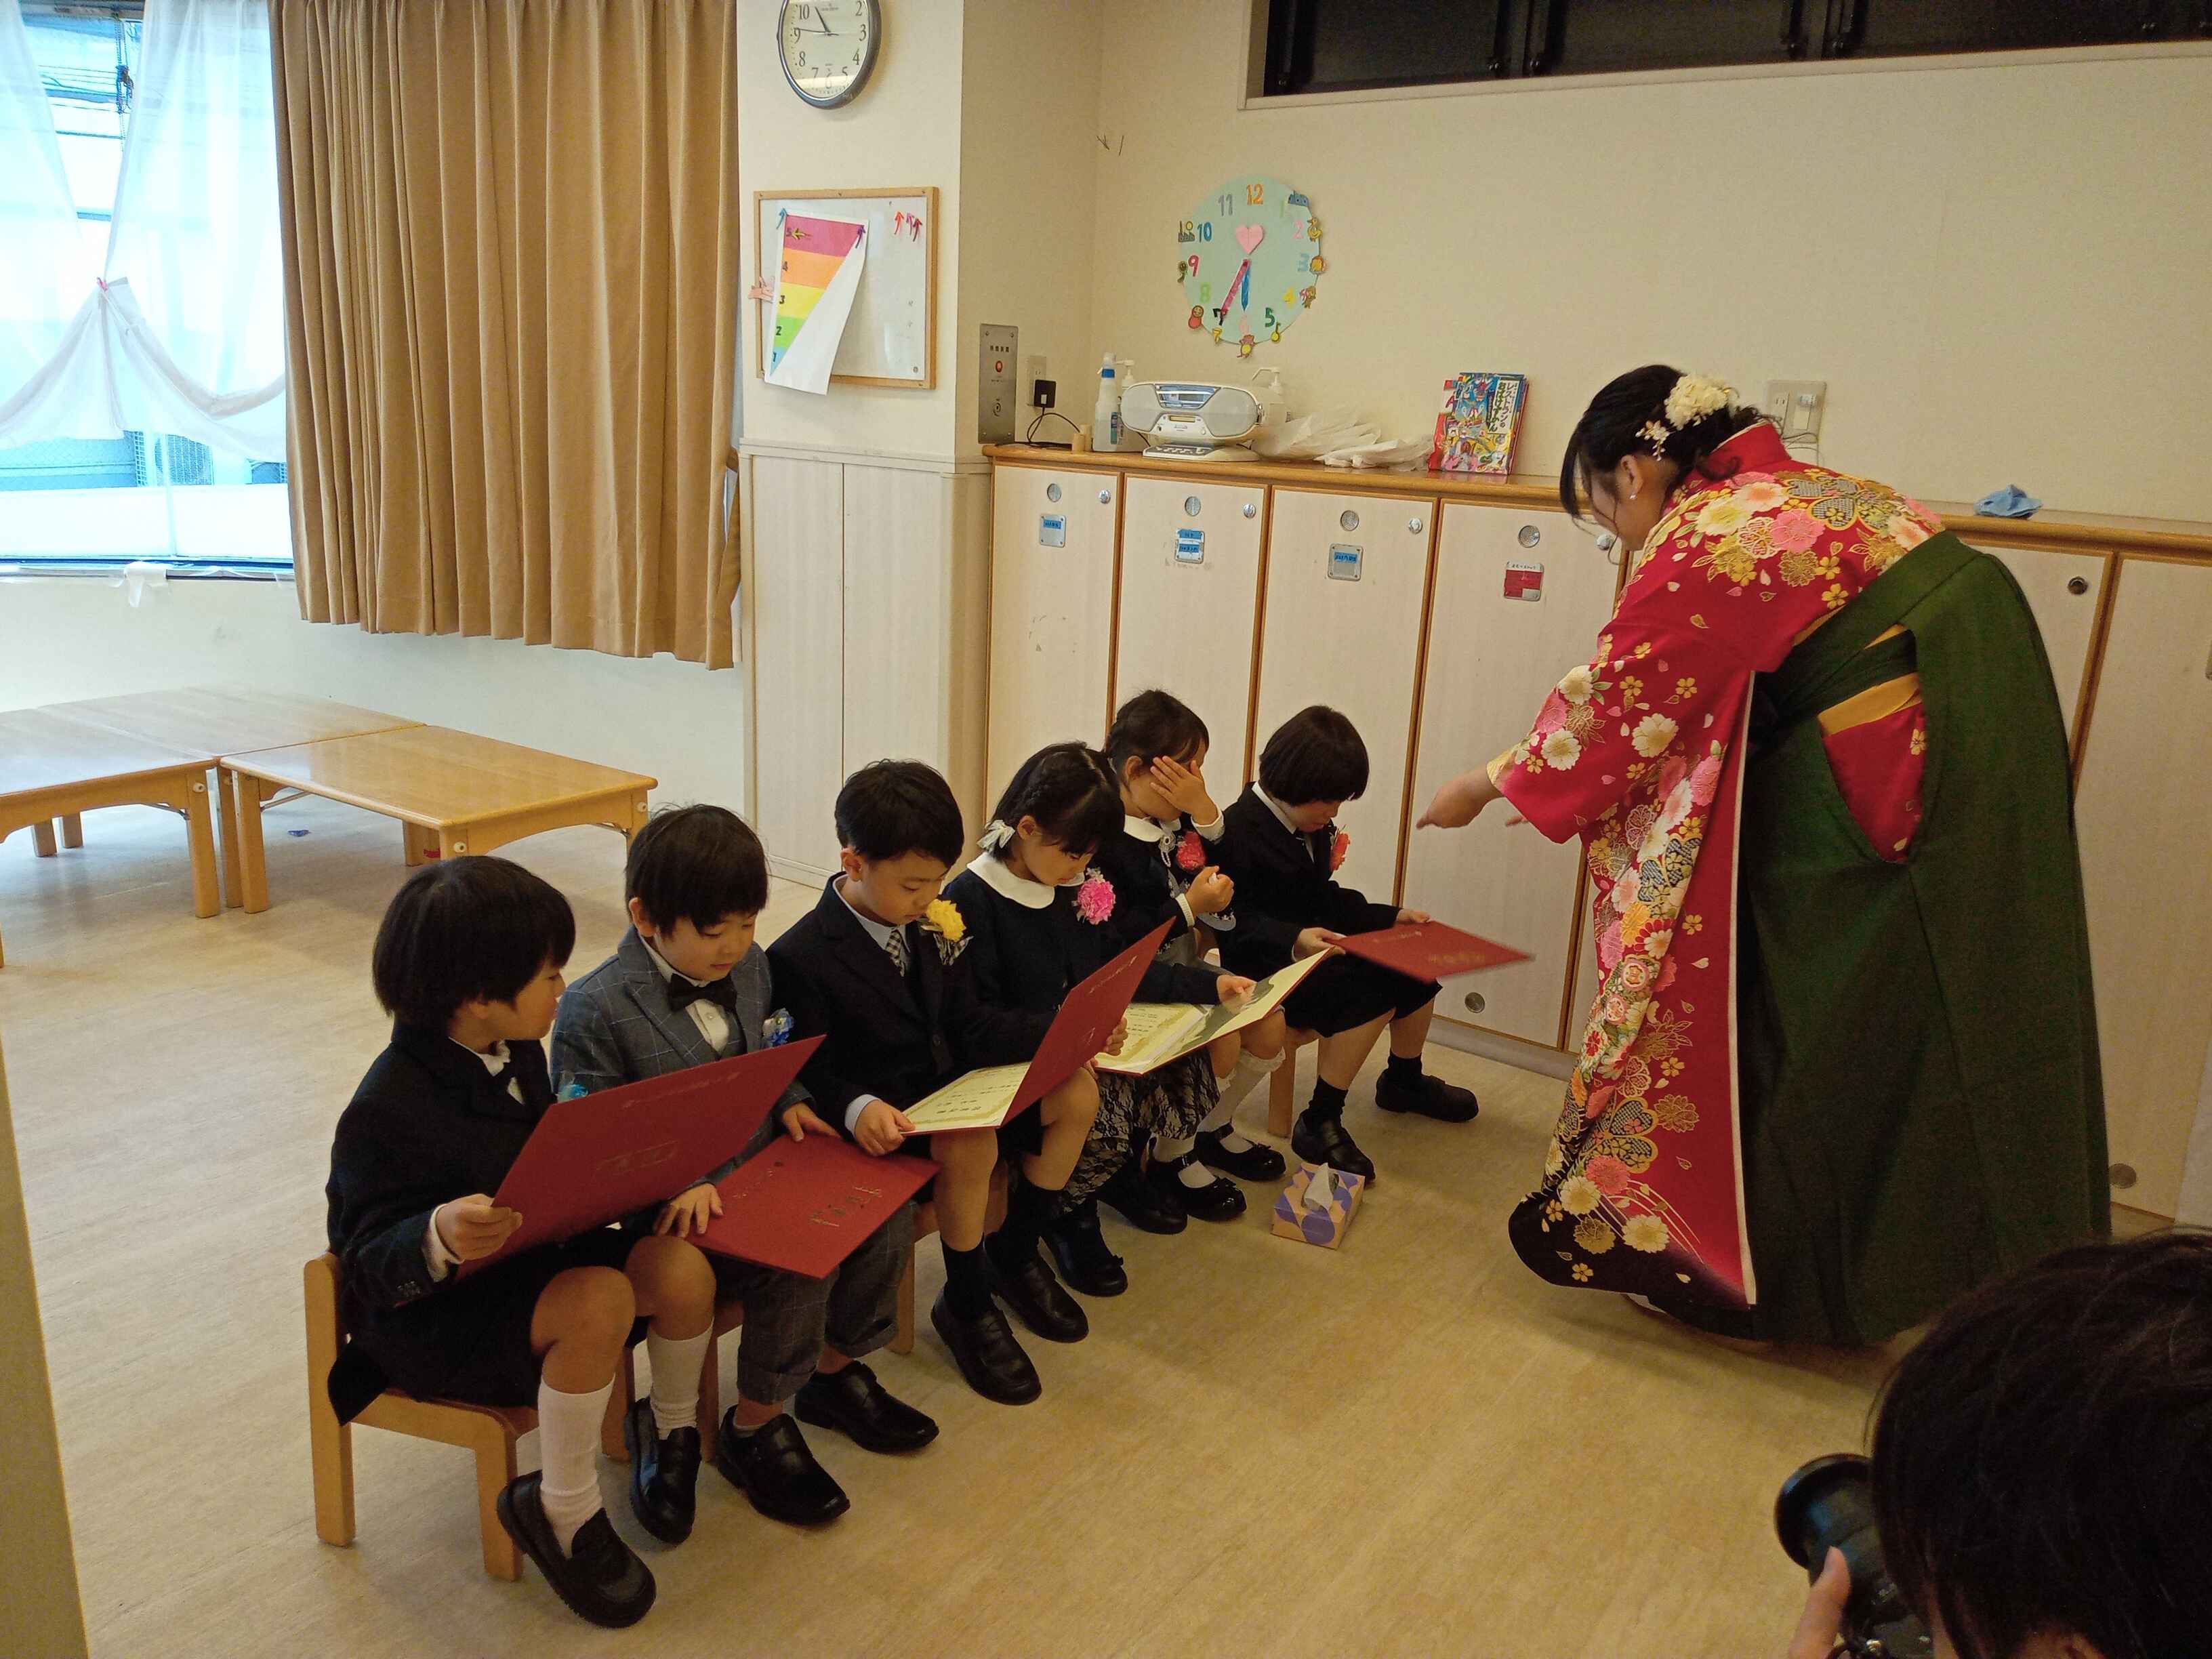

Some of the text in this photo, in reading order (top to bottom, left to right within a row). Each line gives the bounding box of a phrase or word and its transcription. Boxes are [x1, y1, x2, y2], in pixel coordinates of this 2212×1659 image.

[799, 4, 809, 20] 10
[855, 1, 862, 16] 2
[794, 28, 801, 43] 9
[859, 24, 867, 41] 3
[799, 51, 806, 67] 8
[852, 49, 859, 66] 4
[1246, 184, 1264, 205] 12
[1218, 194, 1233, 216] 11
[786, 228, 792, 237] 5
[1197, 222, 1212, 243] 10
[1293, 220, 1305, 239] 2
[782, 261, 789, 271] 4
[1188, 255, 1199, 276] 9
[1298, 253, 1309, 272] 3
[779, 295, 785, 304] 3
[1200, 283, 1211, 303] 8
[1283, 287, 1295, 307] 4
[1213, 308, 1225, 325] 7
[1265, 307, 1275, 327] 5
[775, 326, 782, 336] 2
[772, 352, 777, 362] 1
